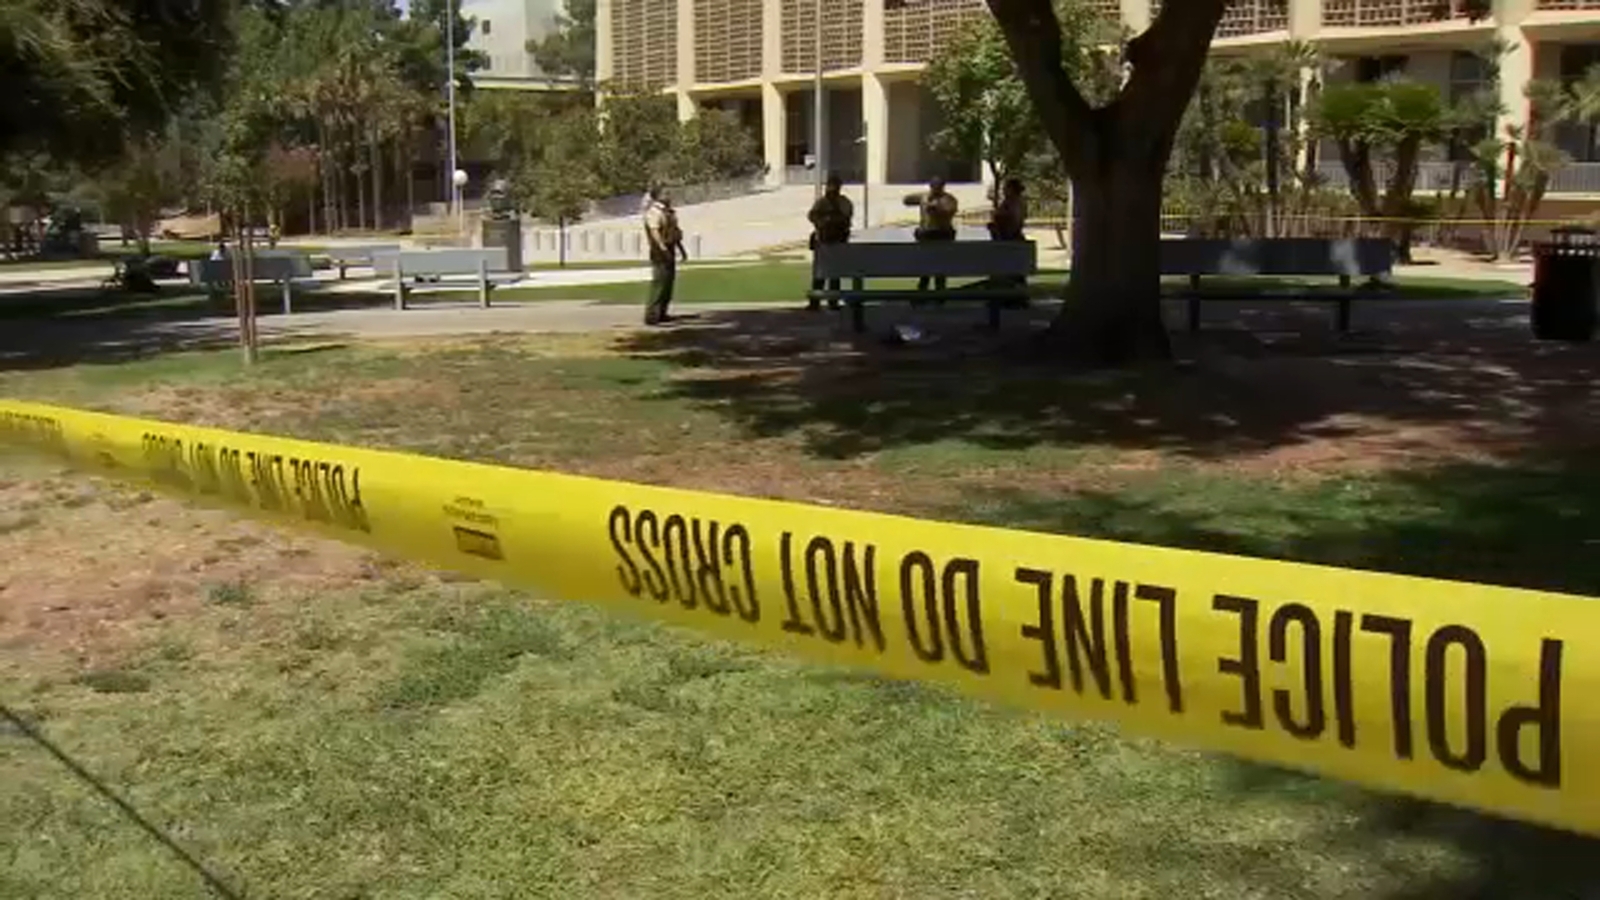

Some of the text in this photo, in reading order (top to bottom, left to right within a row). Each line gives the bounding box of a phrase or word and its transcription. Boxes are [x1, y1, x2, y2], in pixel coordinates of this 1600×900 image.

[290, 459, 371, 533] POLICE
[609, 505, 760, 623] CROSS
[780, 531, 886, 652] NOT
[900, 550, 990, 675] DO
[1015, 567, 1184, 713] LINE
[1212, 594, 1563, 788] POLICE
